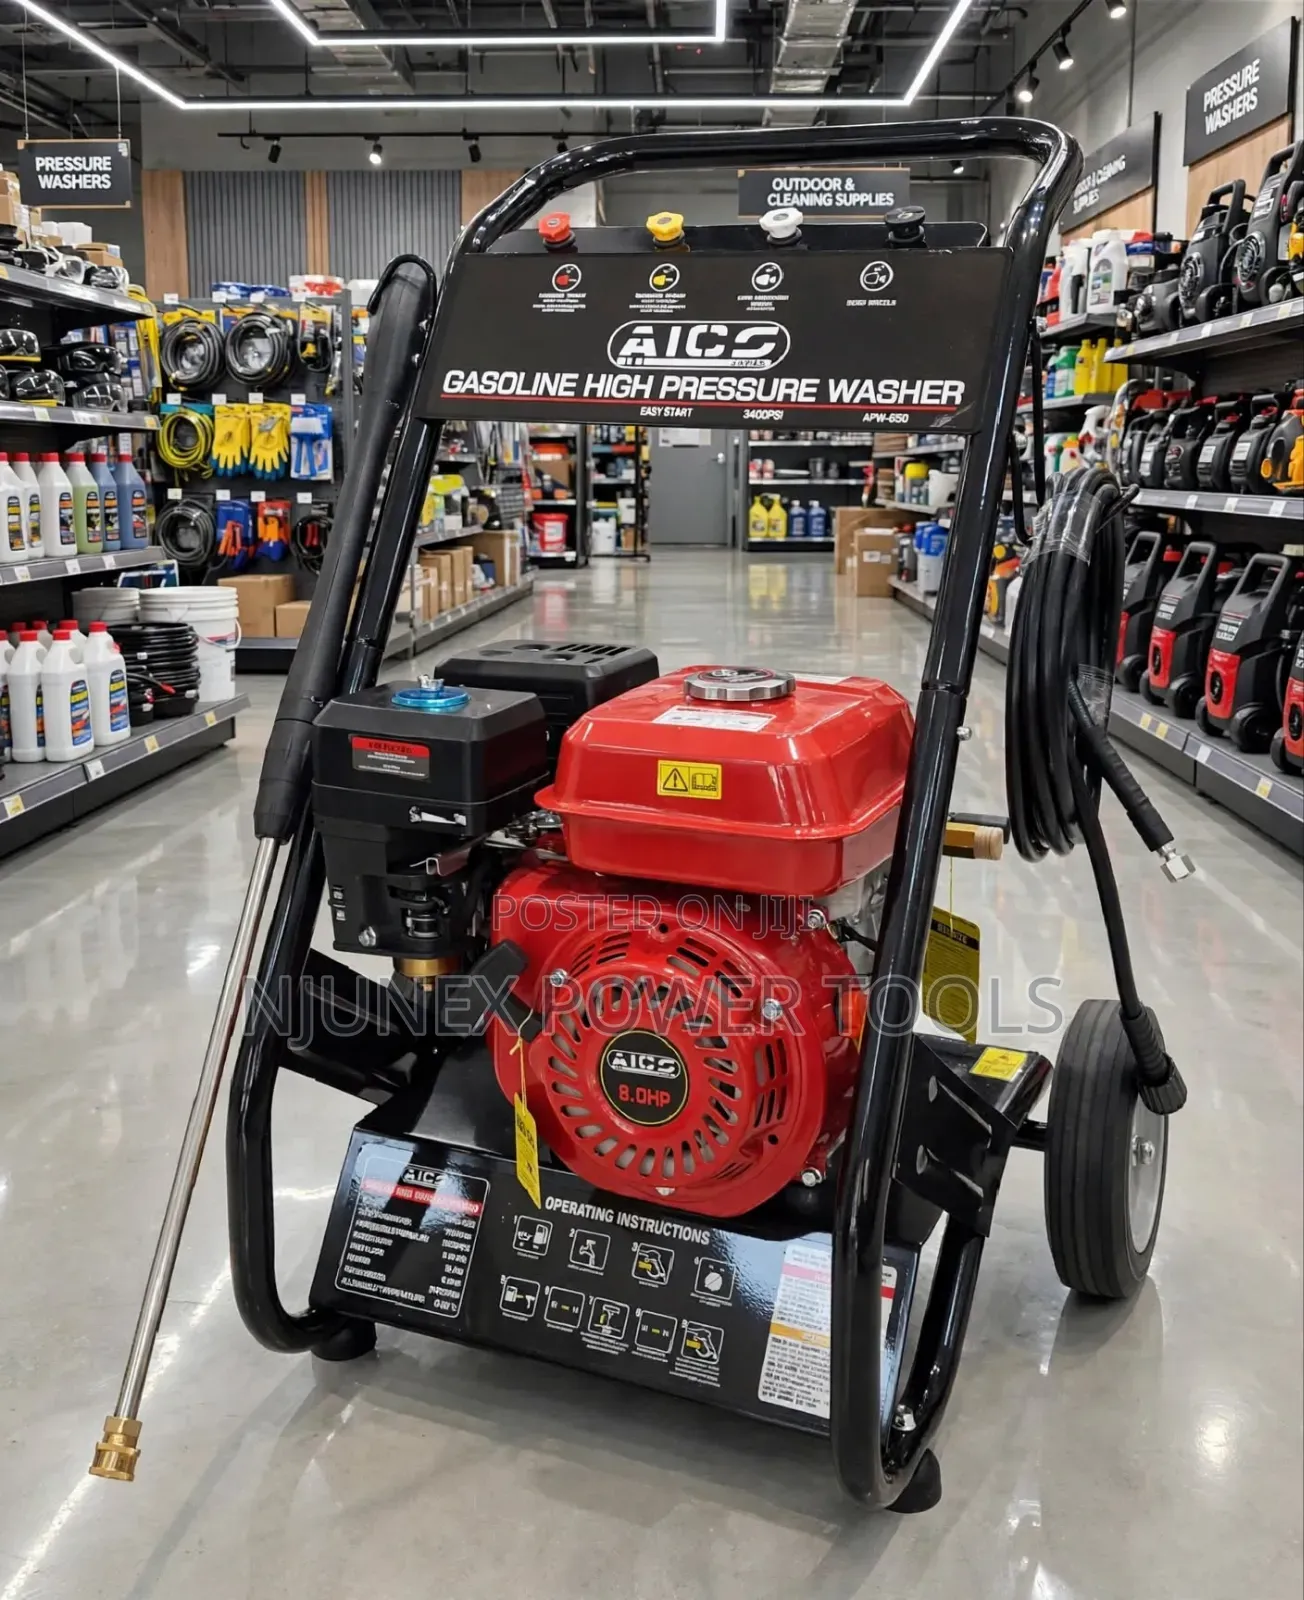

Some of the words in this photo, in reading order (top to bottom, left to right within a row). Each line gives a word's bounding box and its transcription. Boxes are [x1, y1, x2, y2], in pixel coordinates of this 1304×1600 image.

[1203, 58, 1261, 113] PRESSURE
[1205, 87, 1258, 135] WASHERS
[35, 156, 112, 171] PRESSURE
[38, 174, 112, 189] WASHERS
[772, 178, 842, 191] OUTDOOR
[844, 178, 855, 191] &
[767, 193, 833, 206] CLEANING
[835, 193, 894, 206] SUPPLIES
[618, 324, 780, 358] AICS
[443, 370, 578, 396] GASOLINE
[582, 374, 655, 399] HIGH
[659, 376, 820, 402] PRESSURE
[828, 379, 966, 405] WASHER
[640, 406, 663, 416] EASY
[663, 407, 693, 417] START
[743, 410, 783, 420] 3400PSI
[862, 413, 909, 423] APW-650
[612, 1052, 676, 1074] AICS
[618, 1084, 671, 1107] 8.0HP
[545, 1196, 614, 1223] OPERATING
[616, 1212, 711, 1245] INSTRUCTIONS
